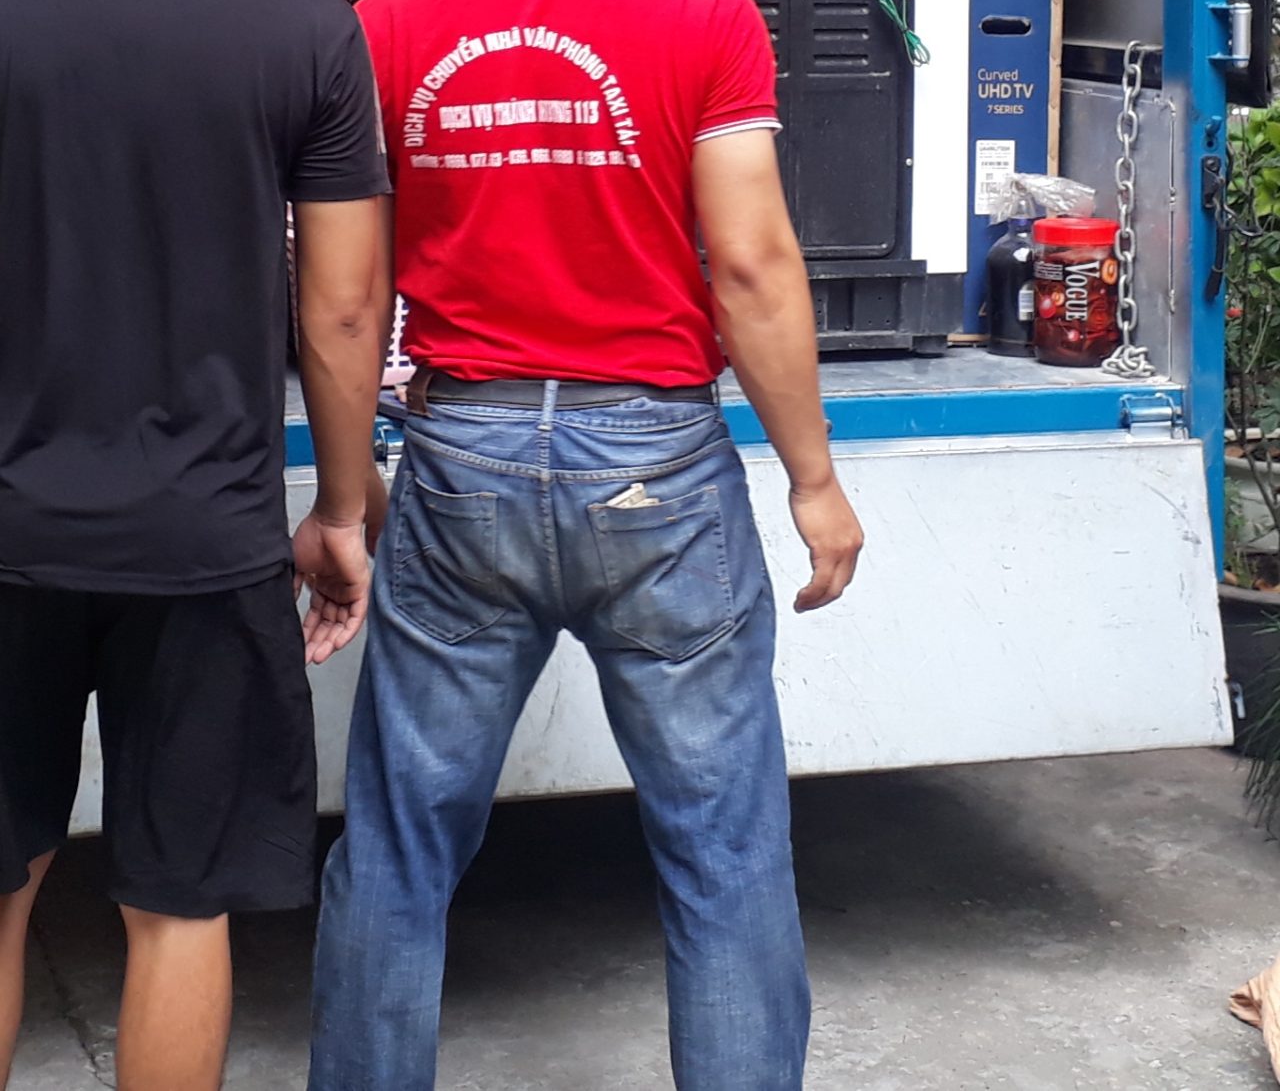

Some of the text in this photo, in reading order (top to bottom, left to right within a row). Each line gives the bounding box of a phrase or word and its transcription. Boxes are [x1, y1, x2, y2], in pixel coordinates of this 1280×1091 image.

[554, 35, 608, 81] PHÒNG
[977, 68, 1019, 81] Curved
[407, 86, 437, 109] VỤ
[600, 74, 630, 117] TAXI
[977, 83, 1034, 99] UHD TV
[573, 100, 600, 125] 113
[986, 104, 1024, 115] 7 SERIES
[403, 112, 427, 147] DỊCH
[1065, 260, 1101, 322] VOGUE
